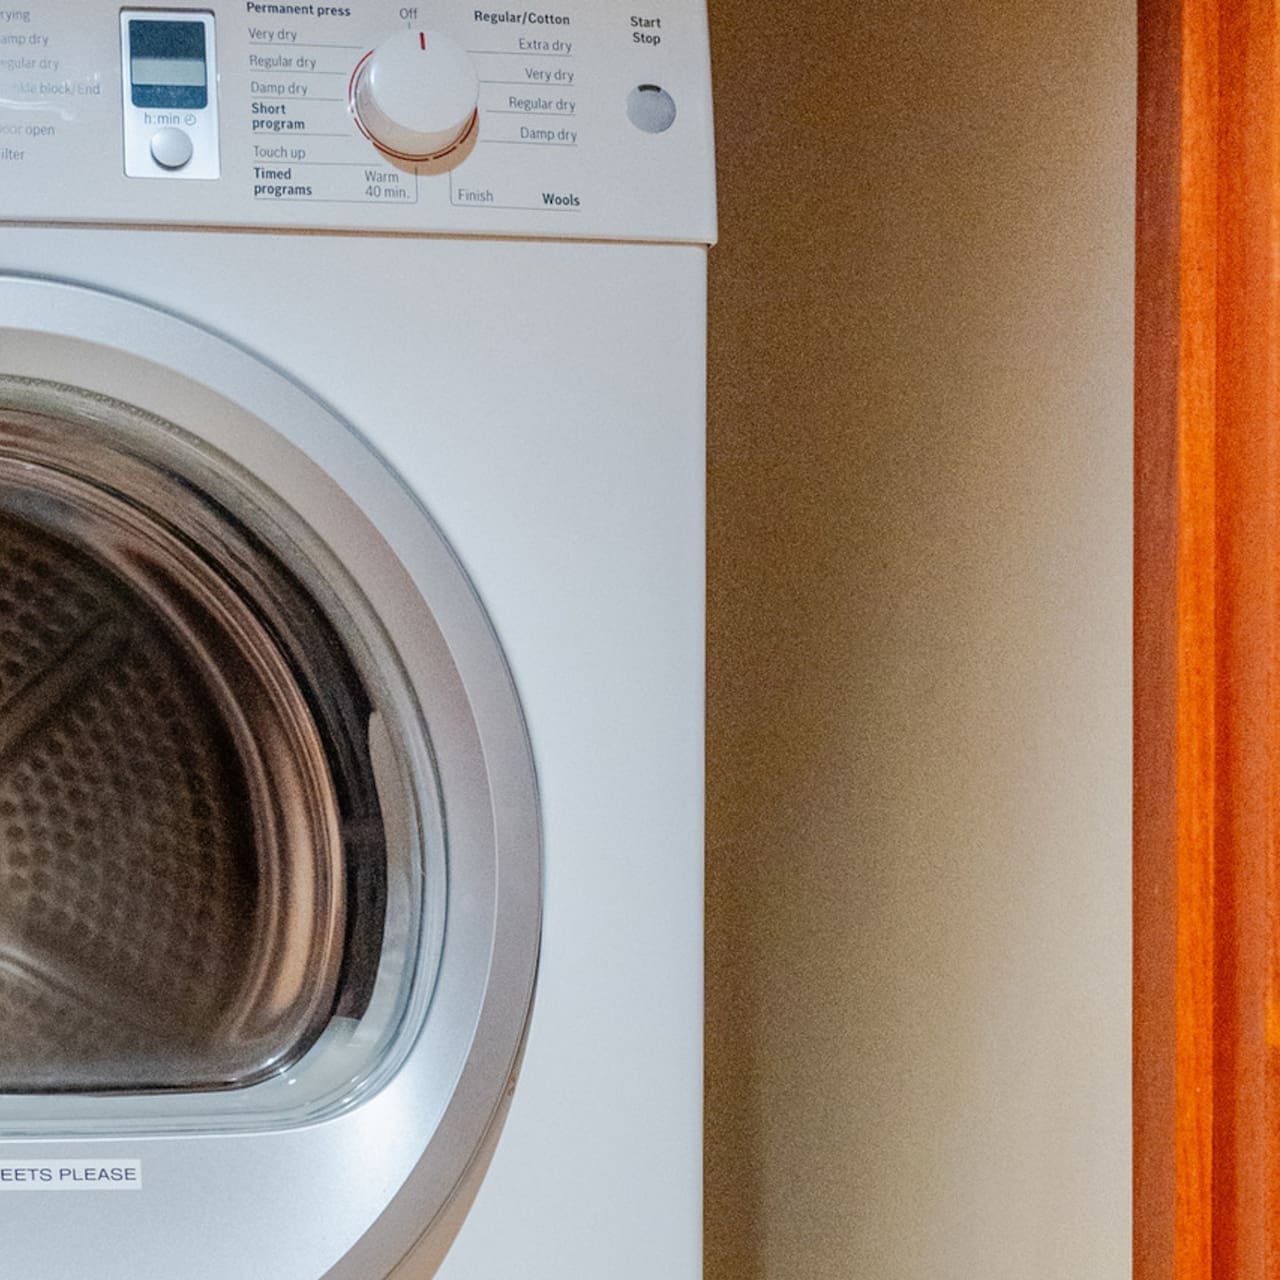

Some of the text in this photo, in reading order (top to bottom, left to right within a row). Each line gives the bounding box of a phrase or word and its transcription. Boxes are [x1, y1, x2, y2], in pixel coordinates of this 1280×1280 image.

[246, 2, 351, 18] Permanent press
[400, 8, 418, 20] Off
[474, 10, 570, 26] Regular/Cotton
[630, 16, 661, 28] Start
[29, 32, 49, 47] dry
[248, 27, 297, 42] Very dry
[633, 32, 661, 45] Stop
[519, 38, 572, 52] Extra dry
[39, 56, 60, 71] dry
[249, 55, 317, 70] Regular dry
[525, 68, 574, 82] Very dry
[251, 81, 308, 96] Damp dry
[252, 102, 286, 115] Short
[509, 97, 576, 112] Regular dry
[144, 111, 180, 125] h:min
[252, 119, 305, 130] program
[25, 125, 56, 138] open
[520, 127, 578, 143] Damp dry
[254, 145, 306, 160] Touch up
[254, 167, 292, 180] Timed
[365, 170, 399, 183] Warm
[254, 184, 312, 197] programs
[365, 185, 410, 198] 40 min.
[458, 188, 494, 202] Finish
[542, 193, 580, 207] Wools
[59, 1167, 137, 1181] PLEASE
